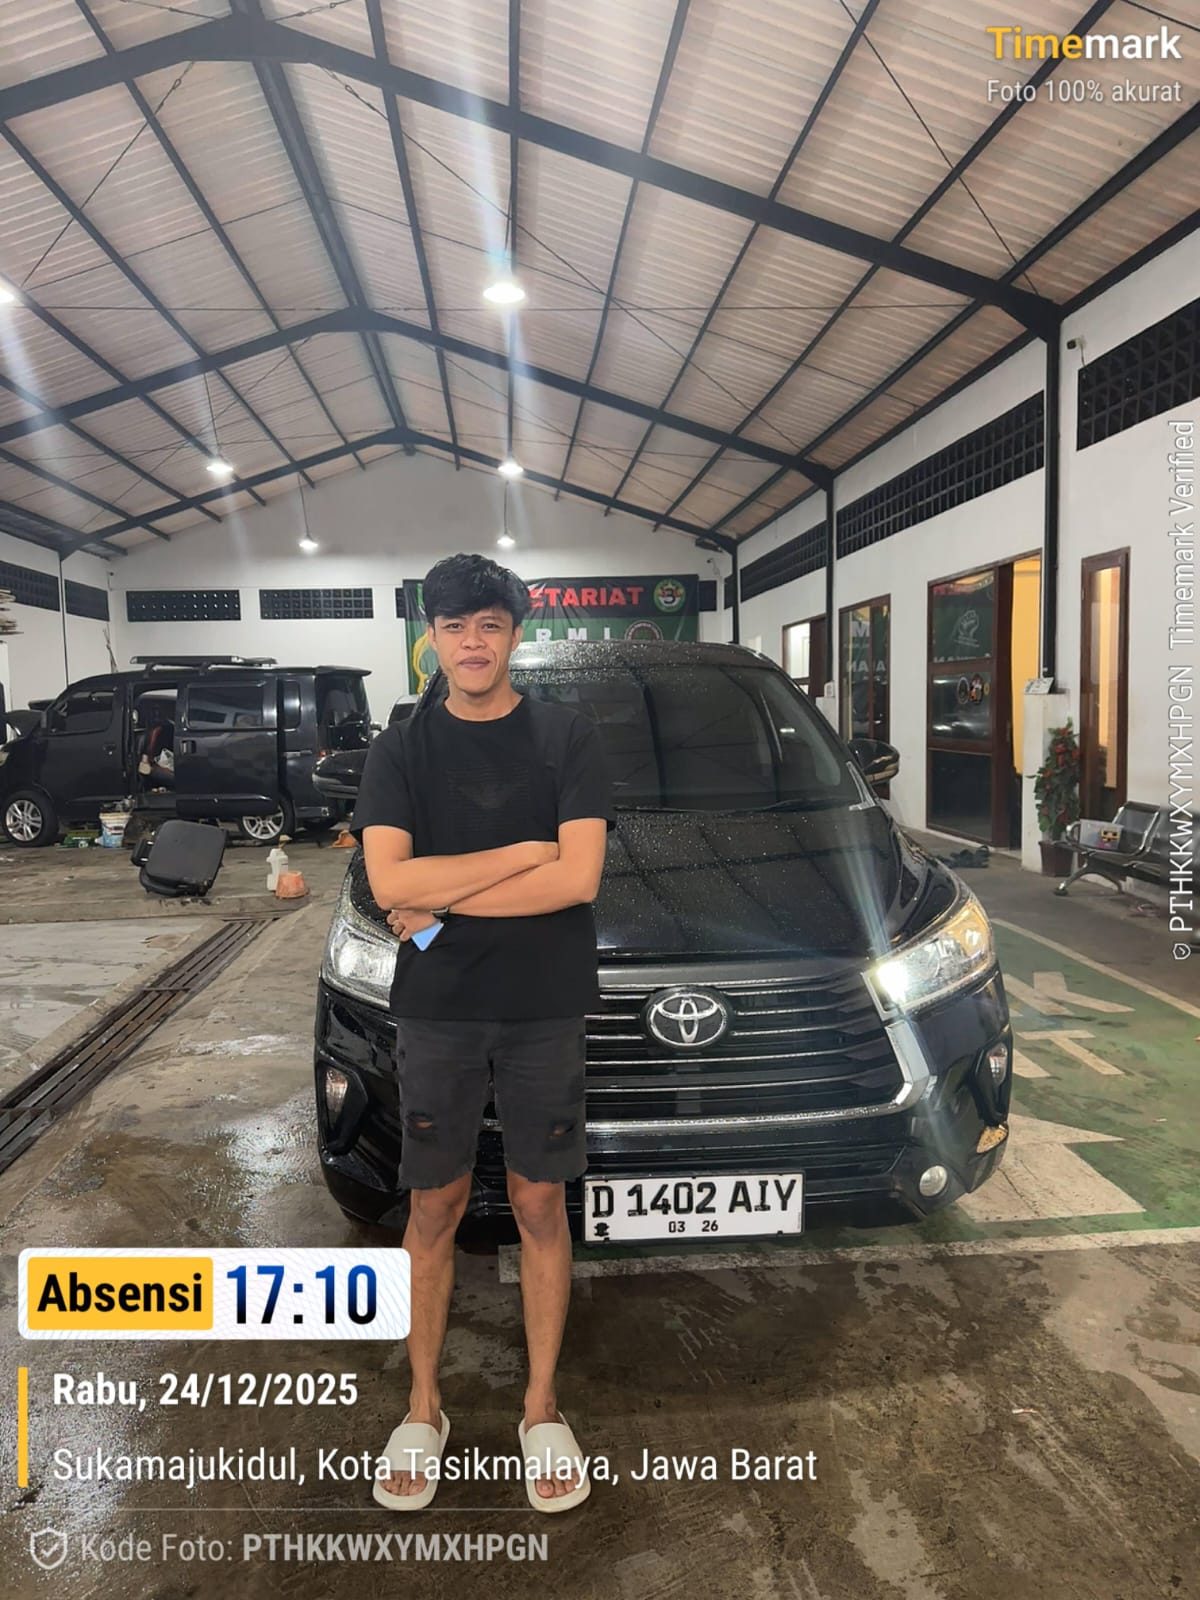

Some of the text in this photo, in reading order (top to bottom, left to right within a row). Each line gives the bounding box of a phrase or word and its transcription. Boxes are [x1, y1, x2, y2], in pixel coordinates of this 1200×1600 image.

[529, 587, 645, 608] ETARIAT
[591, 1186, 614, 1218] D
[627, 1182, 717, 1217] 1402
[728, 1179, 797, 1213] AIY
[668, 1220, 719, 1233] 03 26
